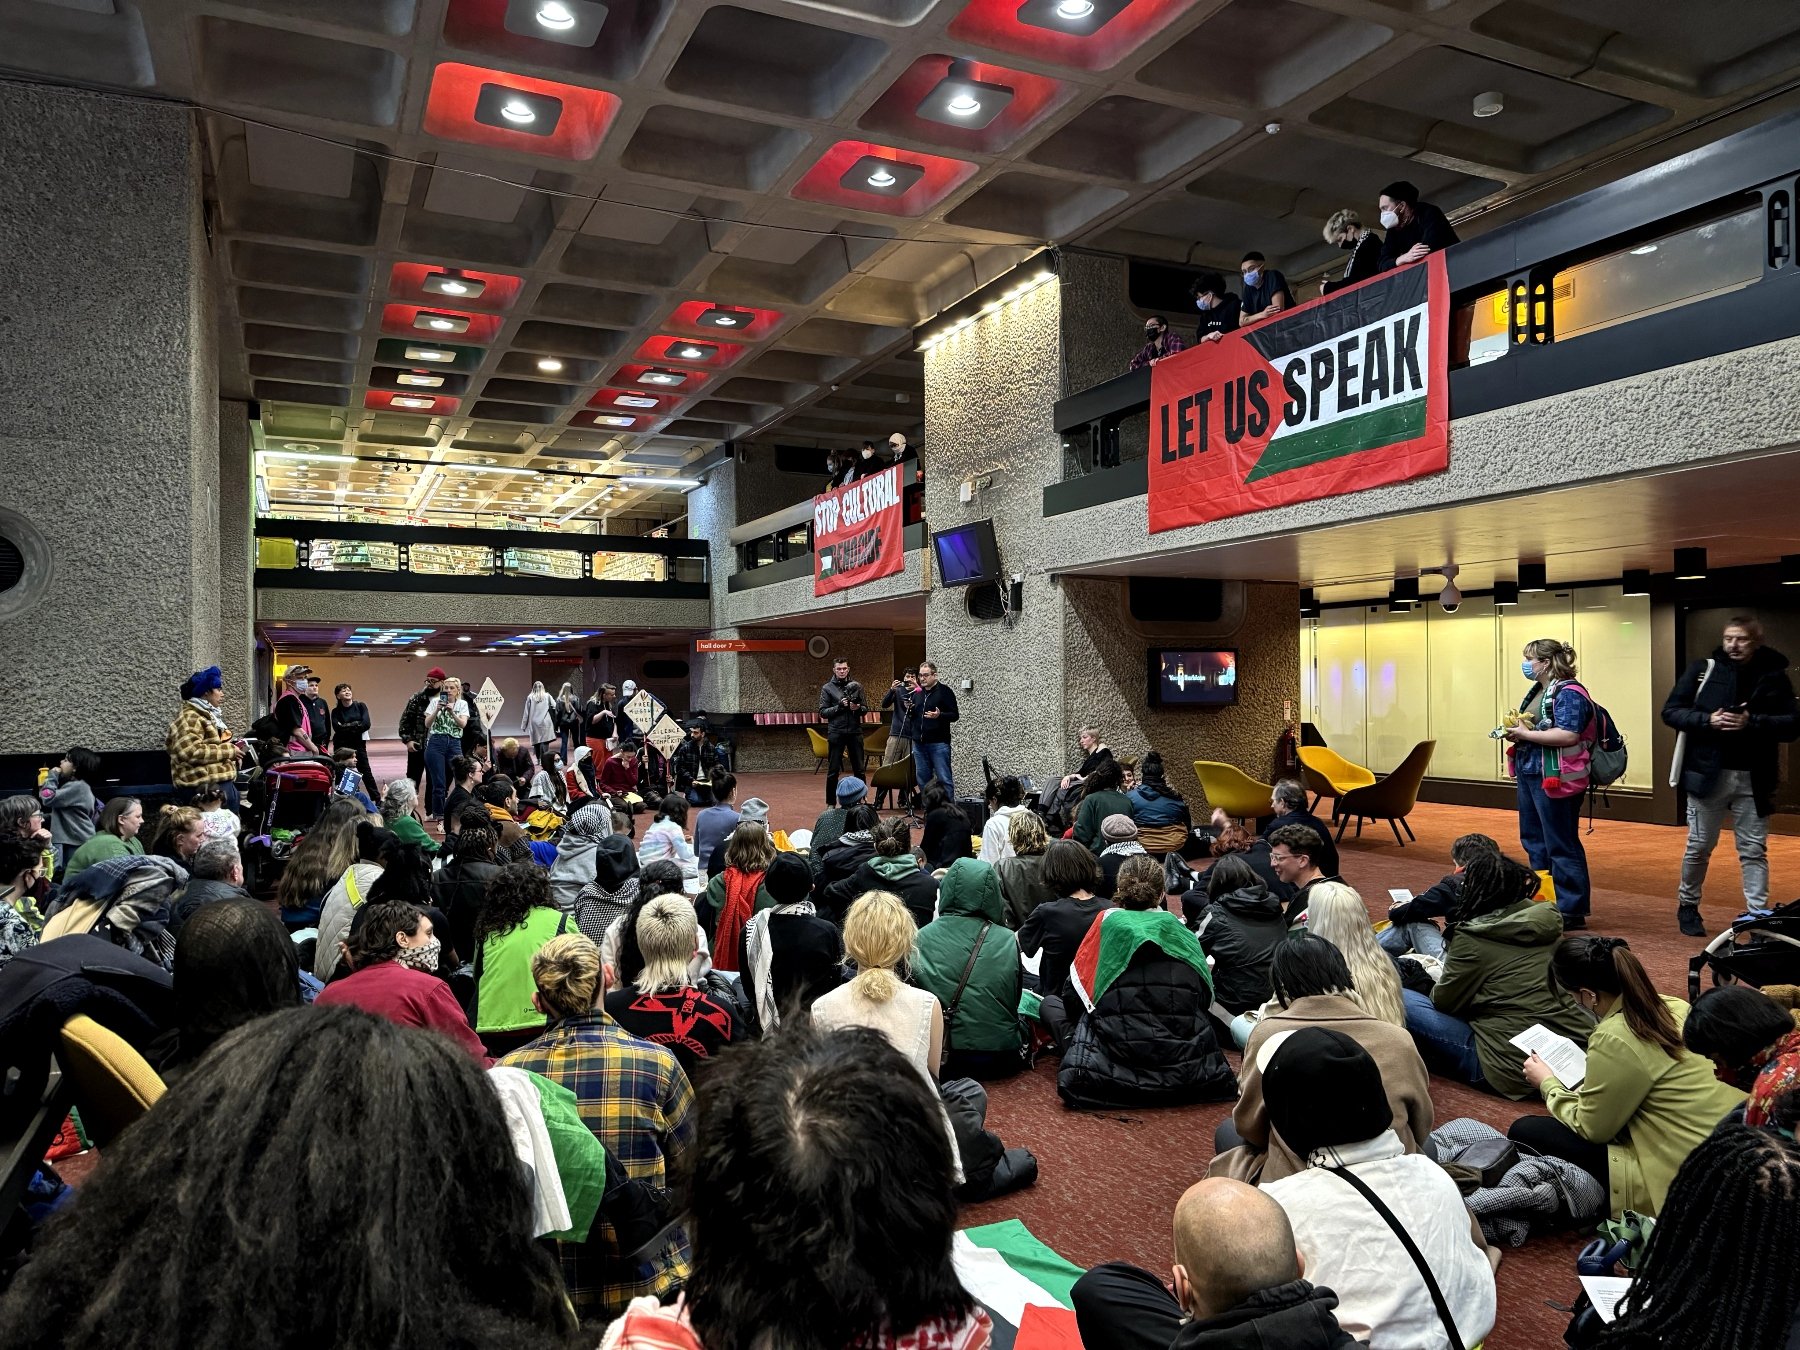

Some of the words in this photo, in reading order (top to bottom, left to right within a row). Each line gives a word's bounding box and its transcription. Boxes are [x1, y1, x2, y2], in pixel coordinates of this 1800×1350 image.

[1160, 388, 1213, 465] LET
[1223, 369, 1271, 445] US
[1282, 311, 1424, 428] SPEAK
[814, 496, 841, 538] STOP
[841, 466, 900, 527] CULTURAL
[652, 727, 680, 735] SILENCE
